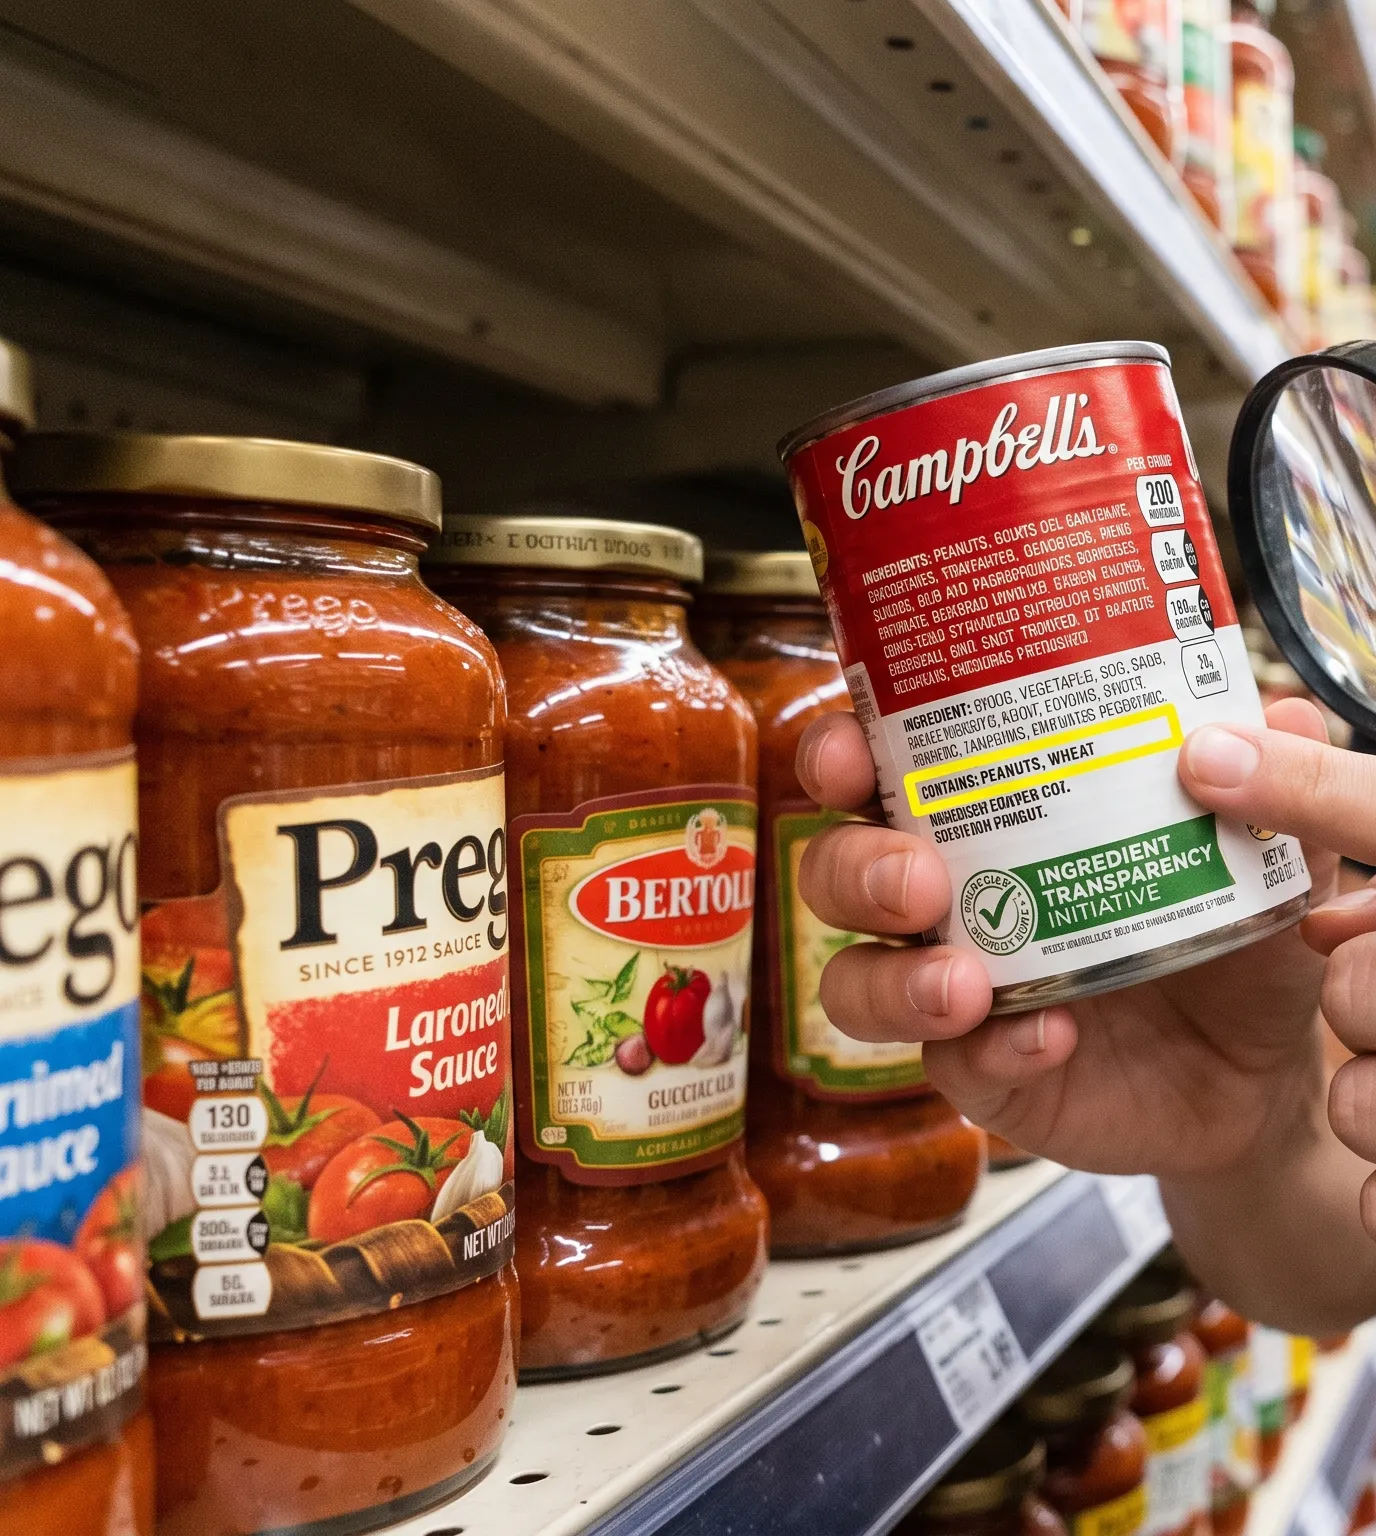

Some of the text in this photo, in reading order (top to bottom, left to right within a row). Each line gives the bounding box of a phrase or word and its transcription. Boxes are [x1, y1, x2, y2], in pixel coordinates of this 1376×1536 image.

[835, 393, 1106, 520] Campbell's
[1126, 455, 1146, 470] PER
[1145, 479, 1174, 505] 200
[862, 553, 932, 586] INGREDIENTS:
[903, 703, 973, 733] INGREDIENT:
[921, 742, 1095, 800] CONTAINS: PEANUTS, WHEAT
[1037, 834, 1171, 887] INGREDIENT
[1041, 843, 1213, 907] TRANSPARENCY
[1047, 882, 1162, 929] INITIATIVE
[299, 954, 375, 982] SINCE
[434, 933, 482, 960] SAUCE
[408, 1041, 498, 1098] Sauce
[207, 1104, 251, 1129] 130
[464, 1228, 486, 1261] NET
